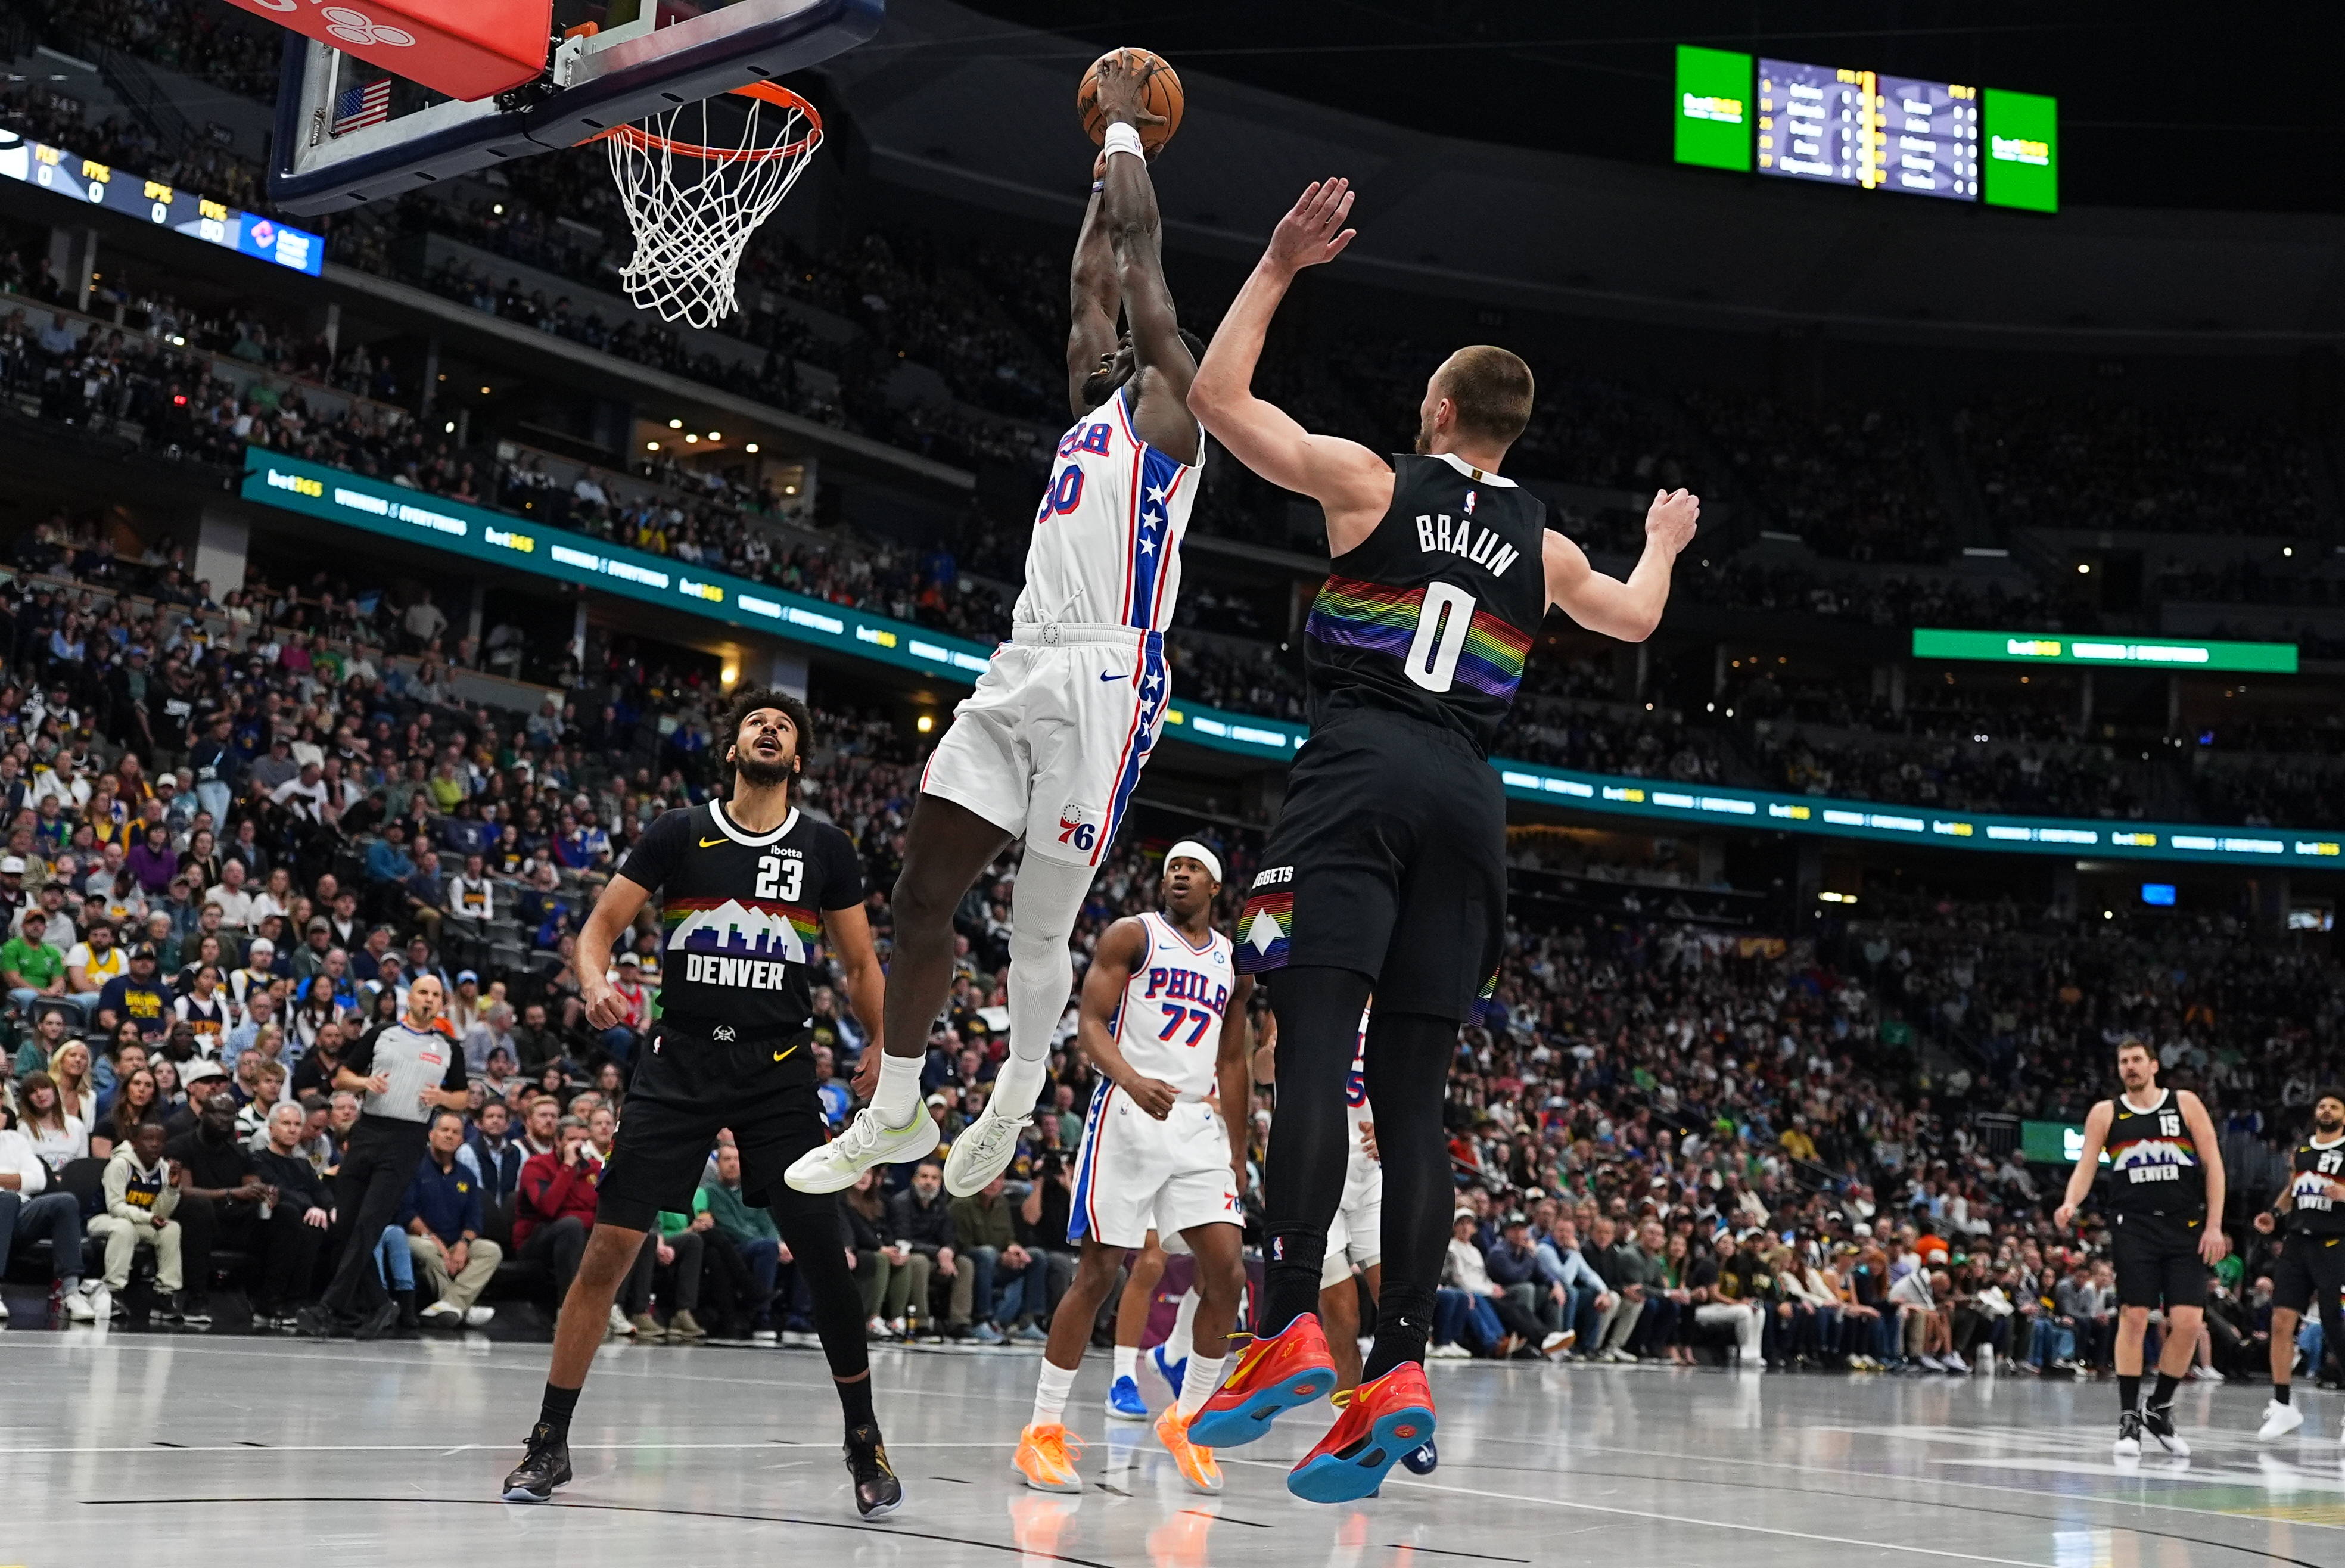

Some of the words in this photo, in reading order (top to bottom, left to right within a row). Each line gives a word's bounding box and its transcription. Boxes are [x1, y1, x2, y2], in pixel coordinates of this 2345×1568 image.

[38, 165, 53, 186] 0
[89, 182, 104, 203] 0
[151, 203, 167, 224] 0
[267, 469, 322, 497] bet365
[485, 526, 534, 553] bet365
[1416, 514, 1519, 578] BRAUN
[1404, 581, 1477, 692] 0
[770, 844, 803, 858] ibotta
[1058, 816, 1096, 851] 76
[755, 855, 804, 902] 23
[686, 953, 785, 990] DENVER
[1145, 967, 1227, 1021] PHILA
[1158, 1003, 1211, 1047] 77
[2159, 1115, 2181, 1137] 15
[2128, 1163, 2179, 1184] DENVER
[2317, 1152, 2343, 1175] 27
